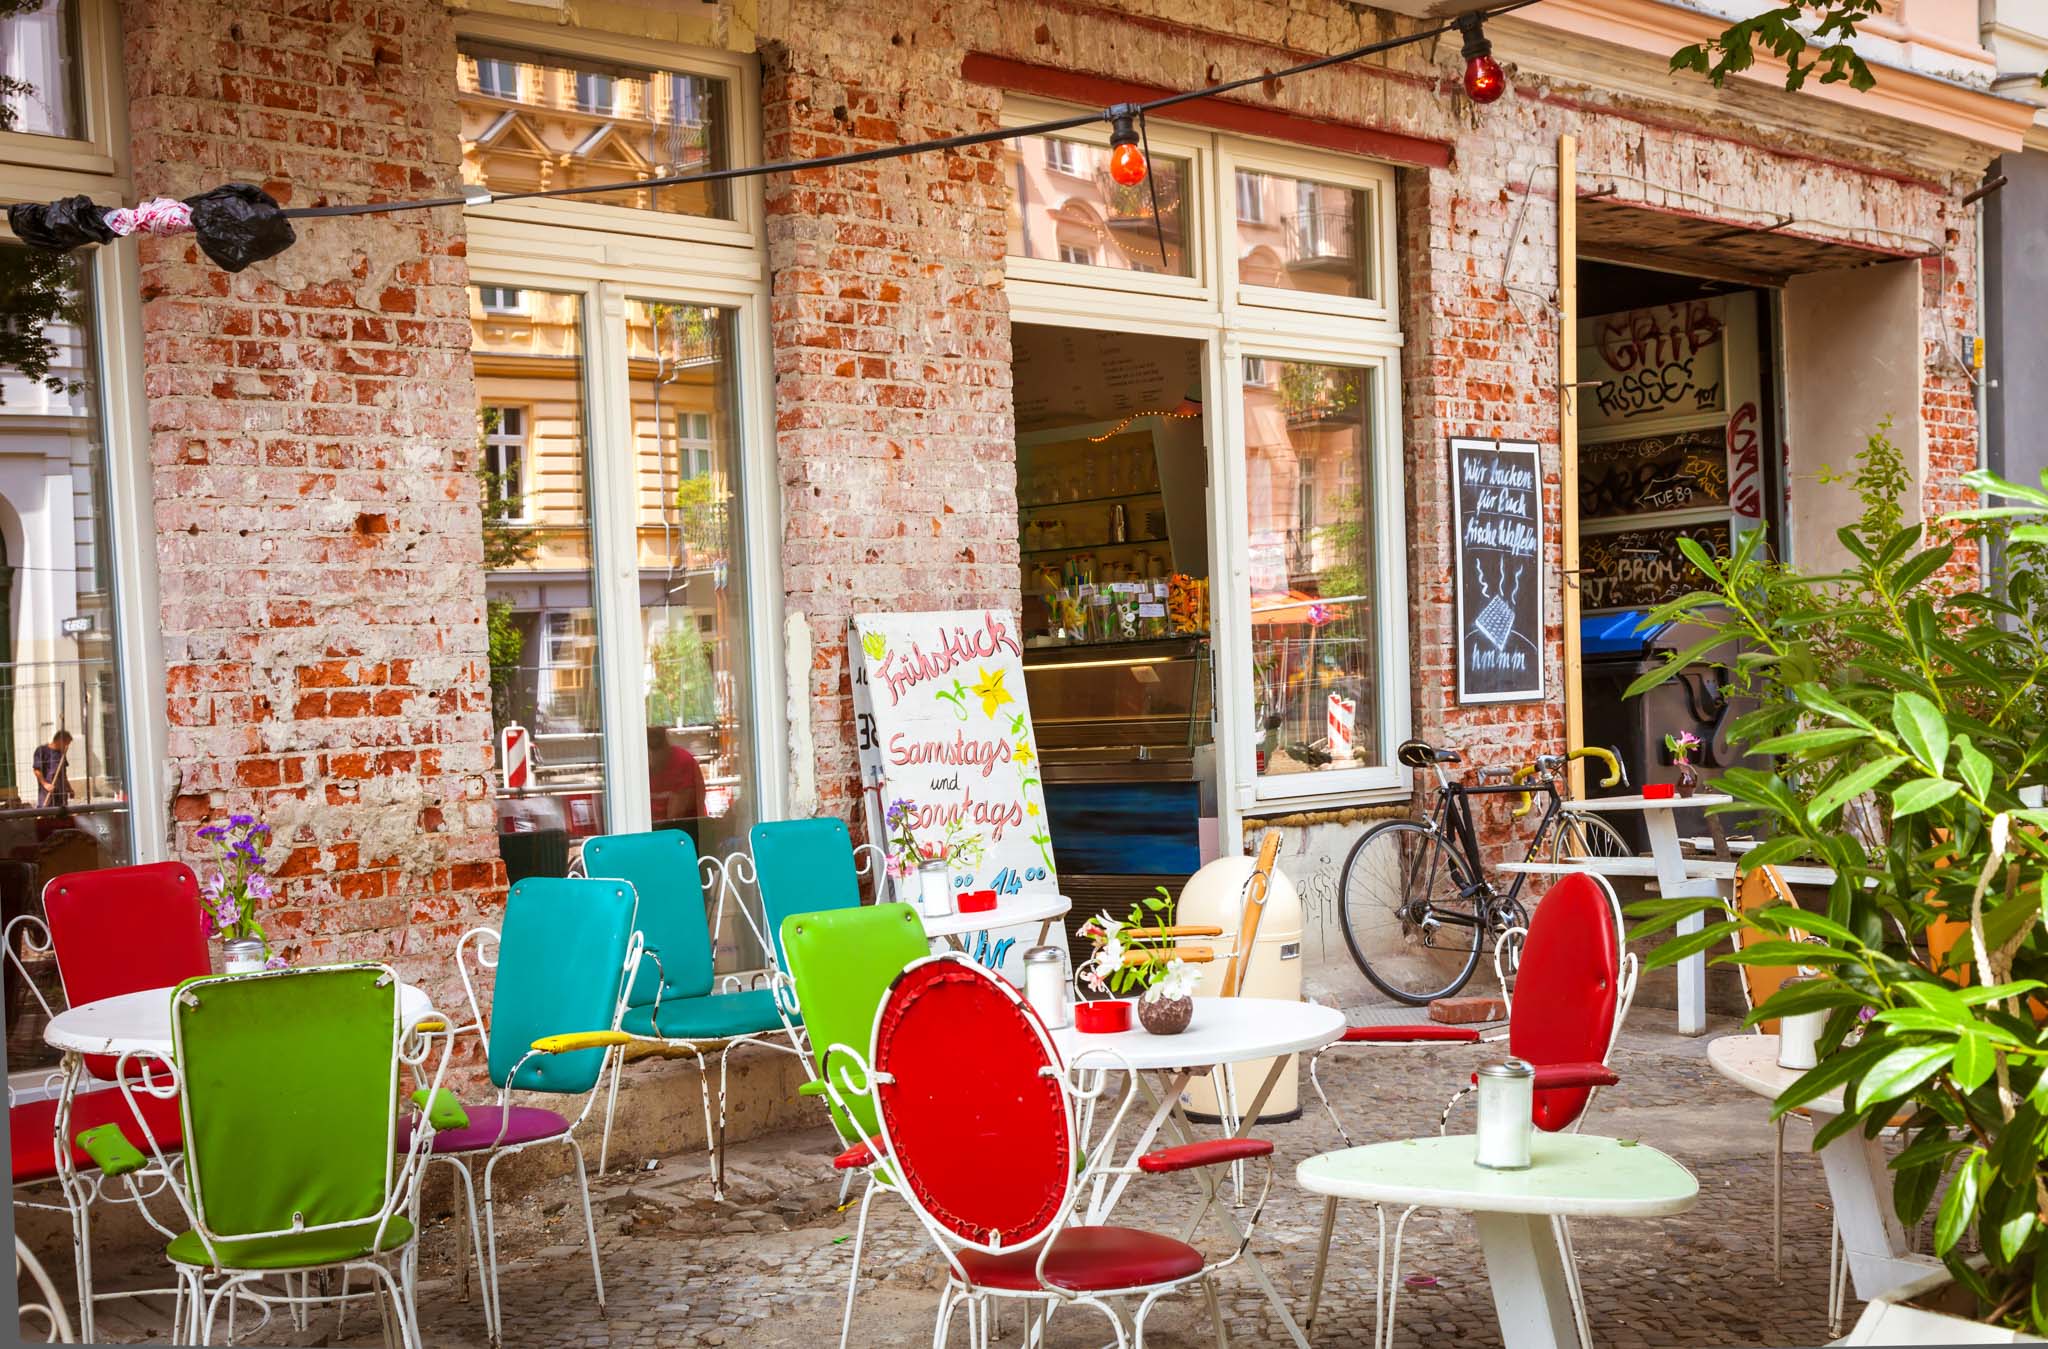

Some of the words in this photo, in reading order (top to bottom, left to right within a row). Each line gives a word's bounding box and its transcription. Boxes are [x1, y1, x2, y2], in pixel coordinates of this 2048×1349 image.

[1463, 456, 1488, 483] Wir
[1476, 489, 1498, 516] für
[1464, 517, 1497, 546] frische
[874, 610, 1021, 706] Frühstück
[889, 729, 1012, 777] Samstags
[930, 772, 960, 791] und
[907, 785, 1023, 842] Sonntags
